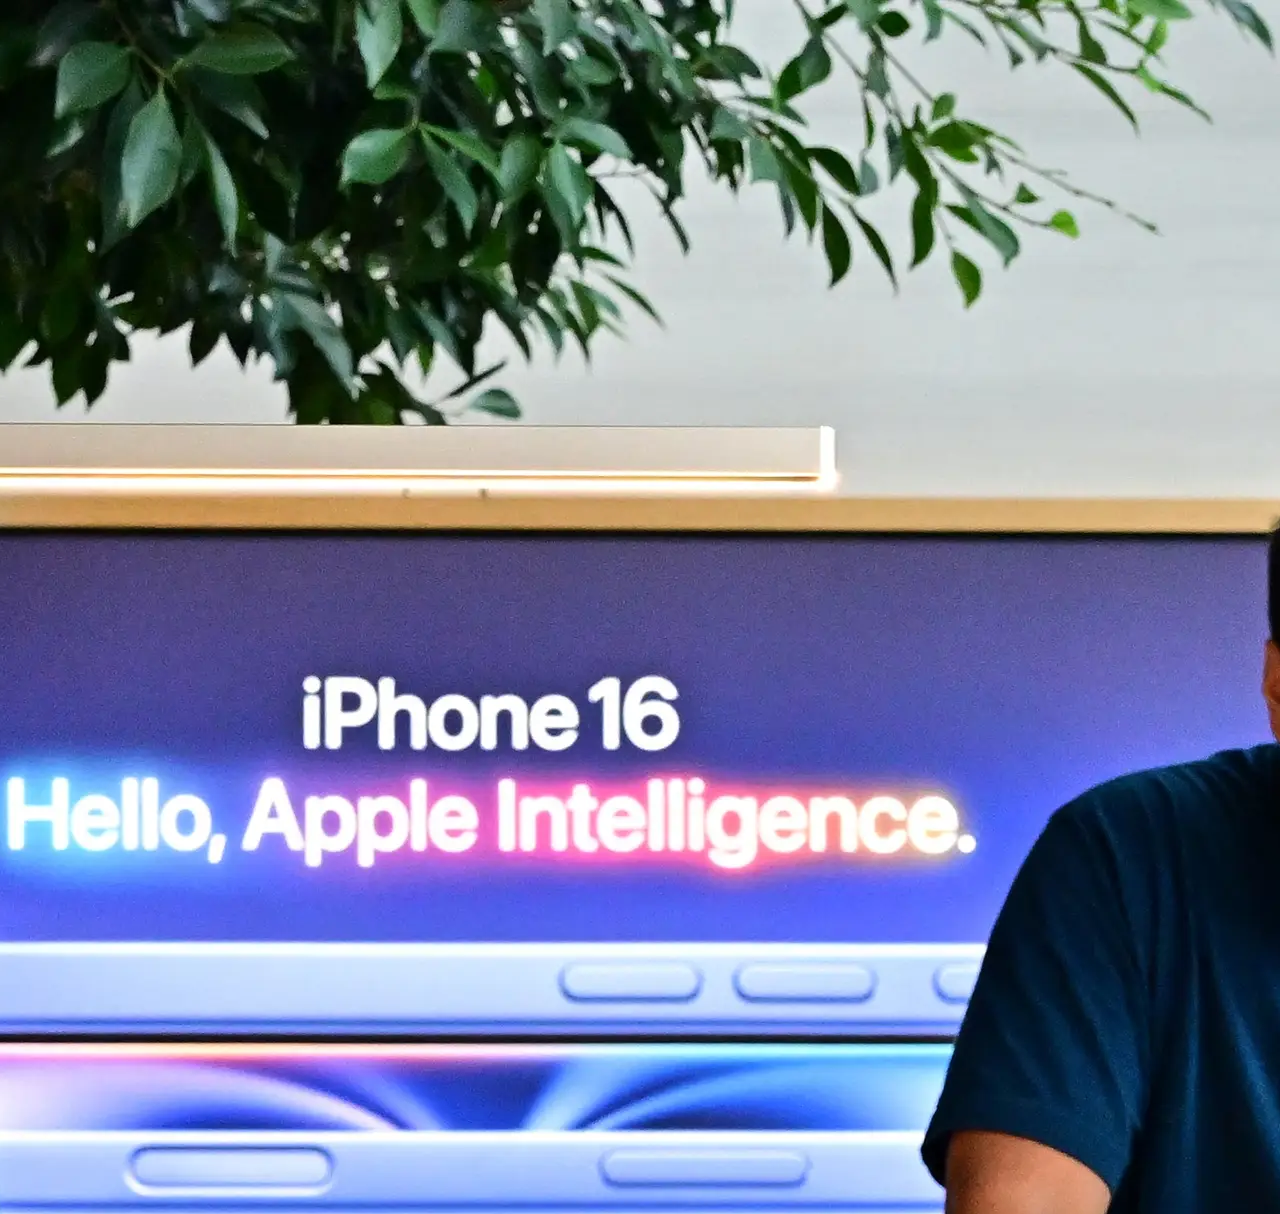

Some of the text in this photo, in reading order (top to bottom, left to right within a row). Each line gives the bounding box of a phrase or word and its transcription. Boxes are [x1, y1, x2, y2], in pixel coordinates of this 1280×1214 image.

[302, 675, 680, 751] iPhone 16
[7, 777, 977, 869] Hello, Apple Intelligence.
